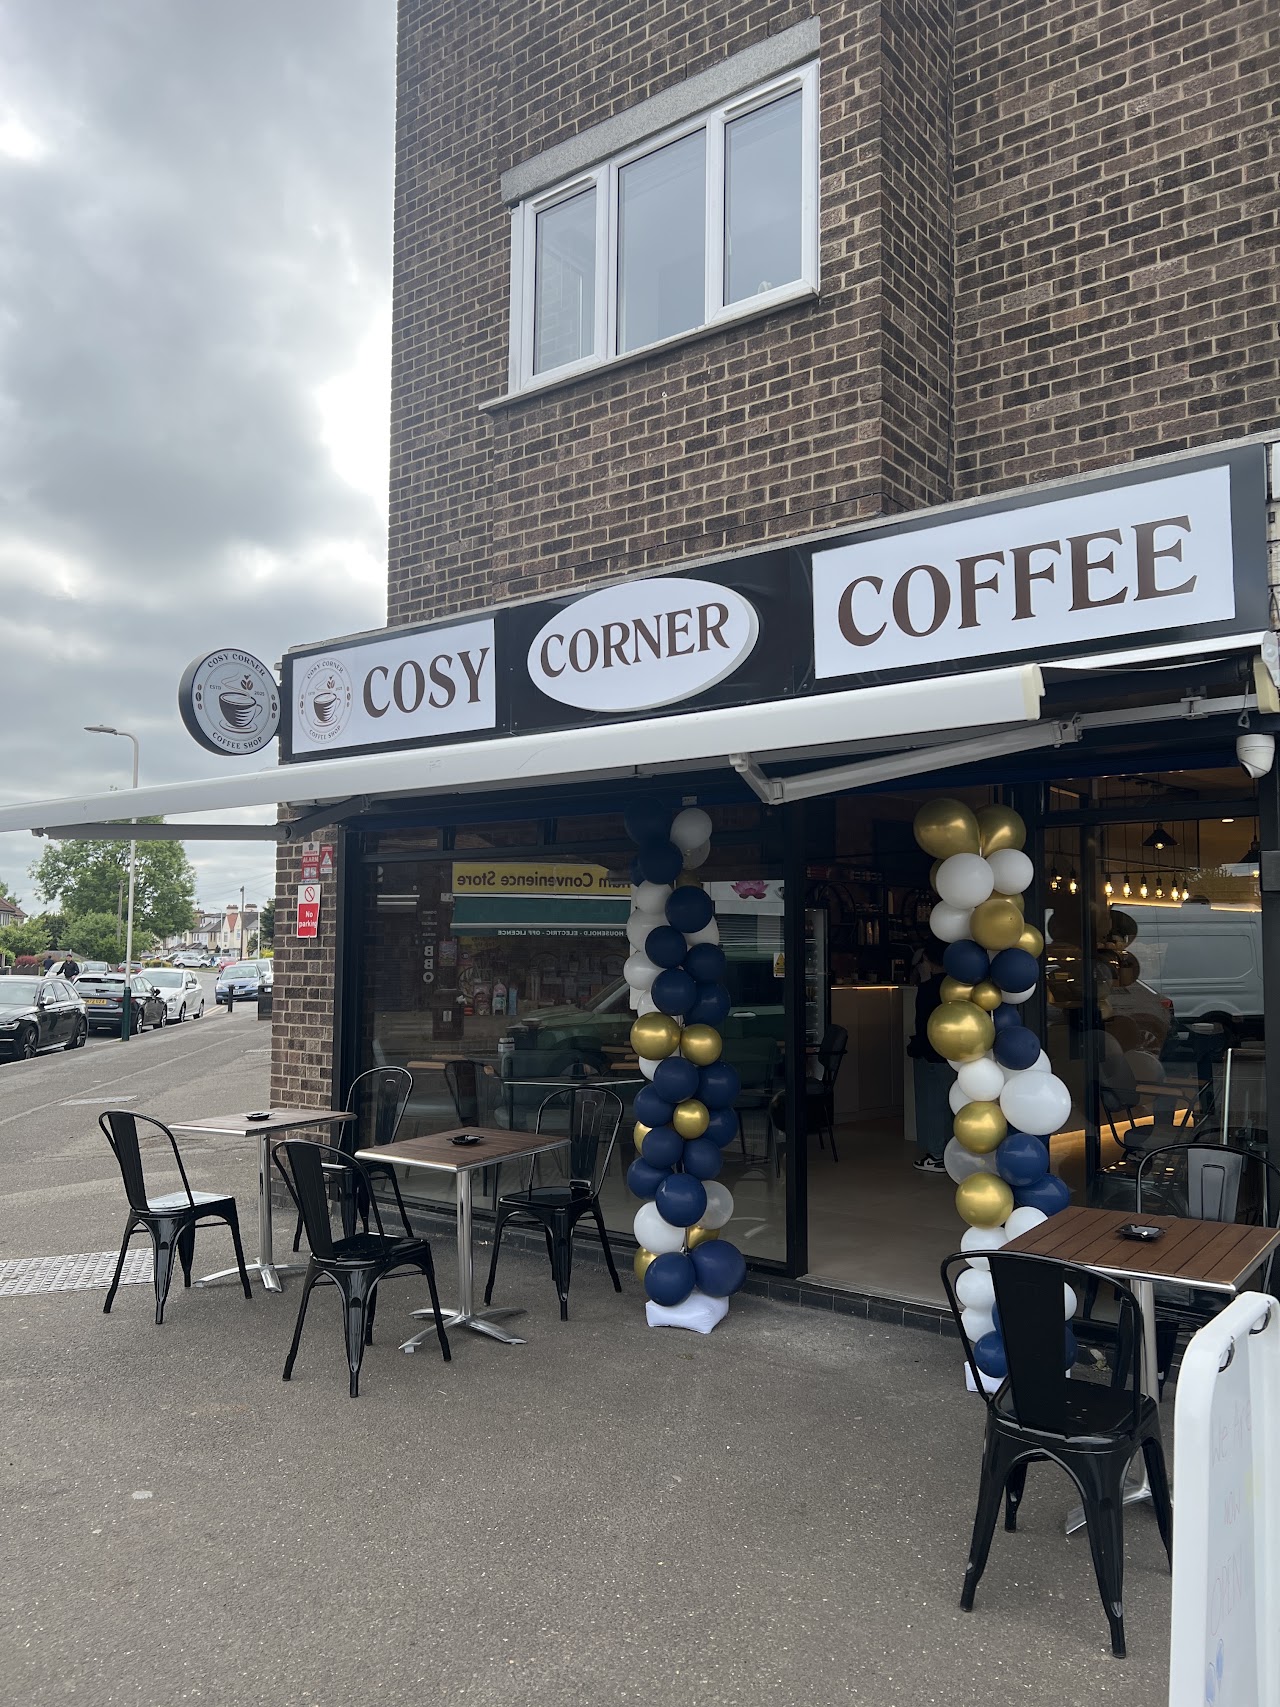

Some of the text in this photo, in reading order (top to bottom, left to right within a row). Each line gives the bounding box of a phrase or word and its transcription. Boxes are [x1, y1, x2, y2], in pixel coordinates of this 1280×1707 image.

[363, 516, 1197, 718] COSY CORNER COFFEE
[208, 654, 266, 677] COSY CORNER
[322, 661, 343, 674] CORNER
[212, 732, 262, 749] COFFEE SHOP
[309, 725, 341, 740] COFFEE SHOP
[299, 920, 317, 929] parking
